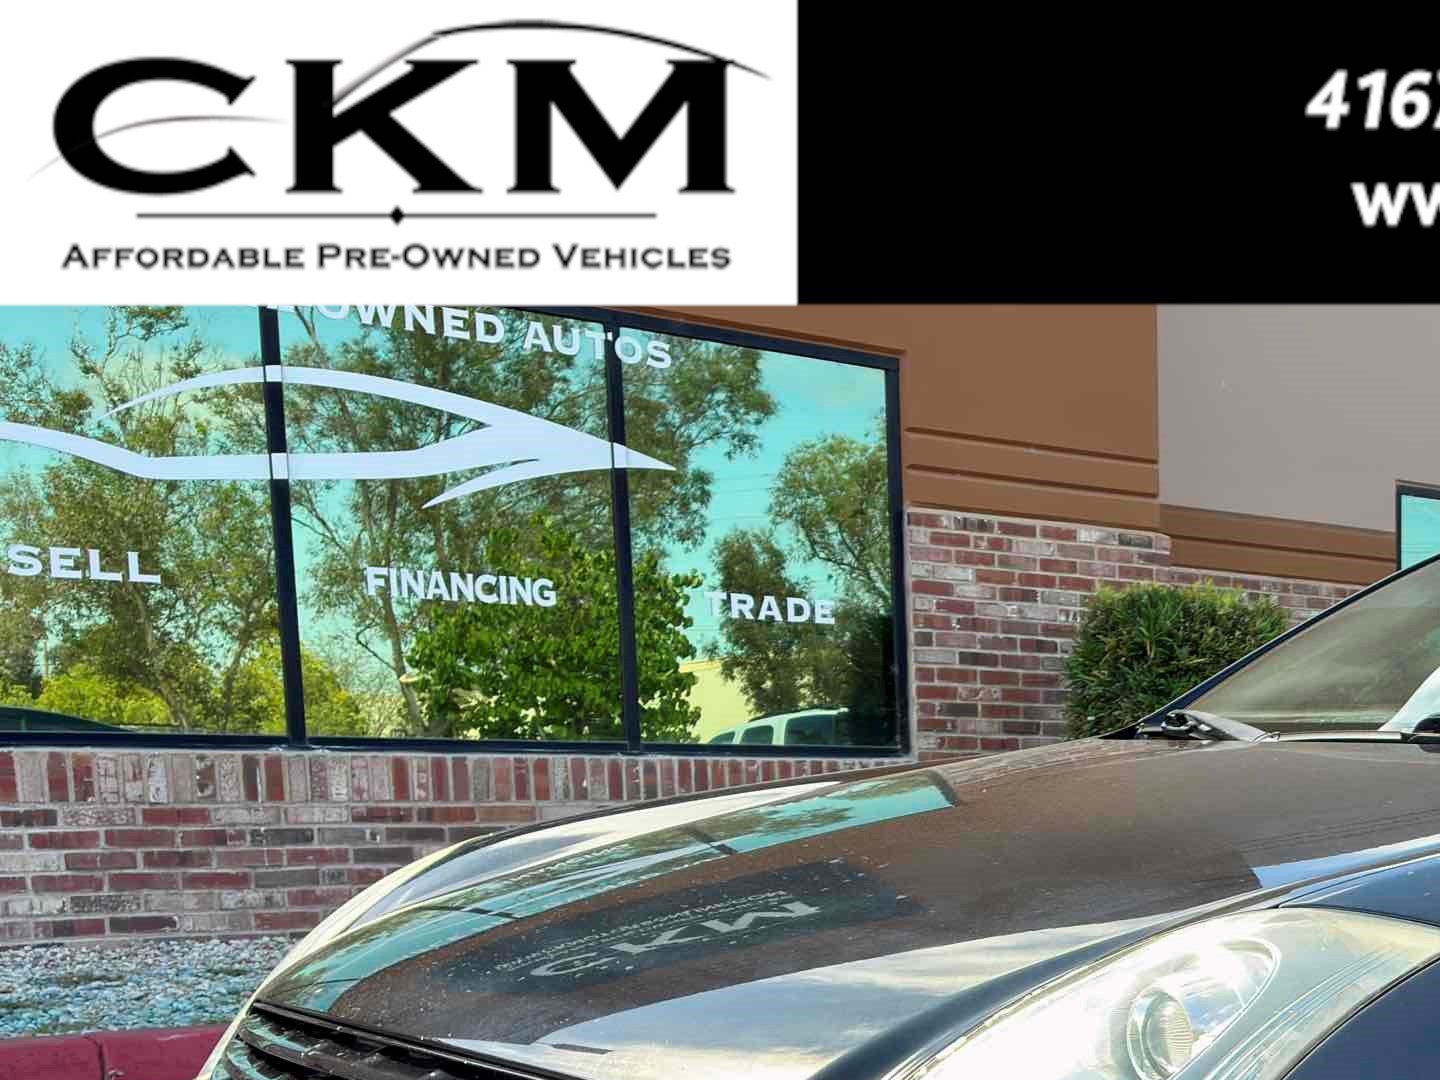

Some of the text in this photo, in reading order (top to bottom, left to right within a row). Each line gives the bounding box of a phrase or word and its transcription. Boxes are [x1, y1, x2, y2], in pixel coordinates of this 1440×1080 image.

[522, 320, 673, 370] AUTOS
[7, 544, 162, 585] SELL
[365, 566, 558, 607] FINANCING
[704, 590, 837, 626] TRADE
